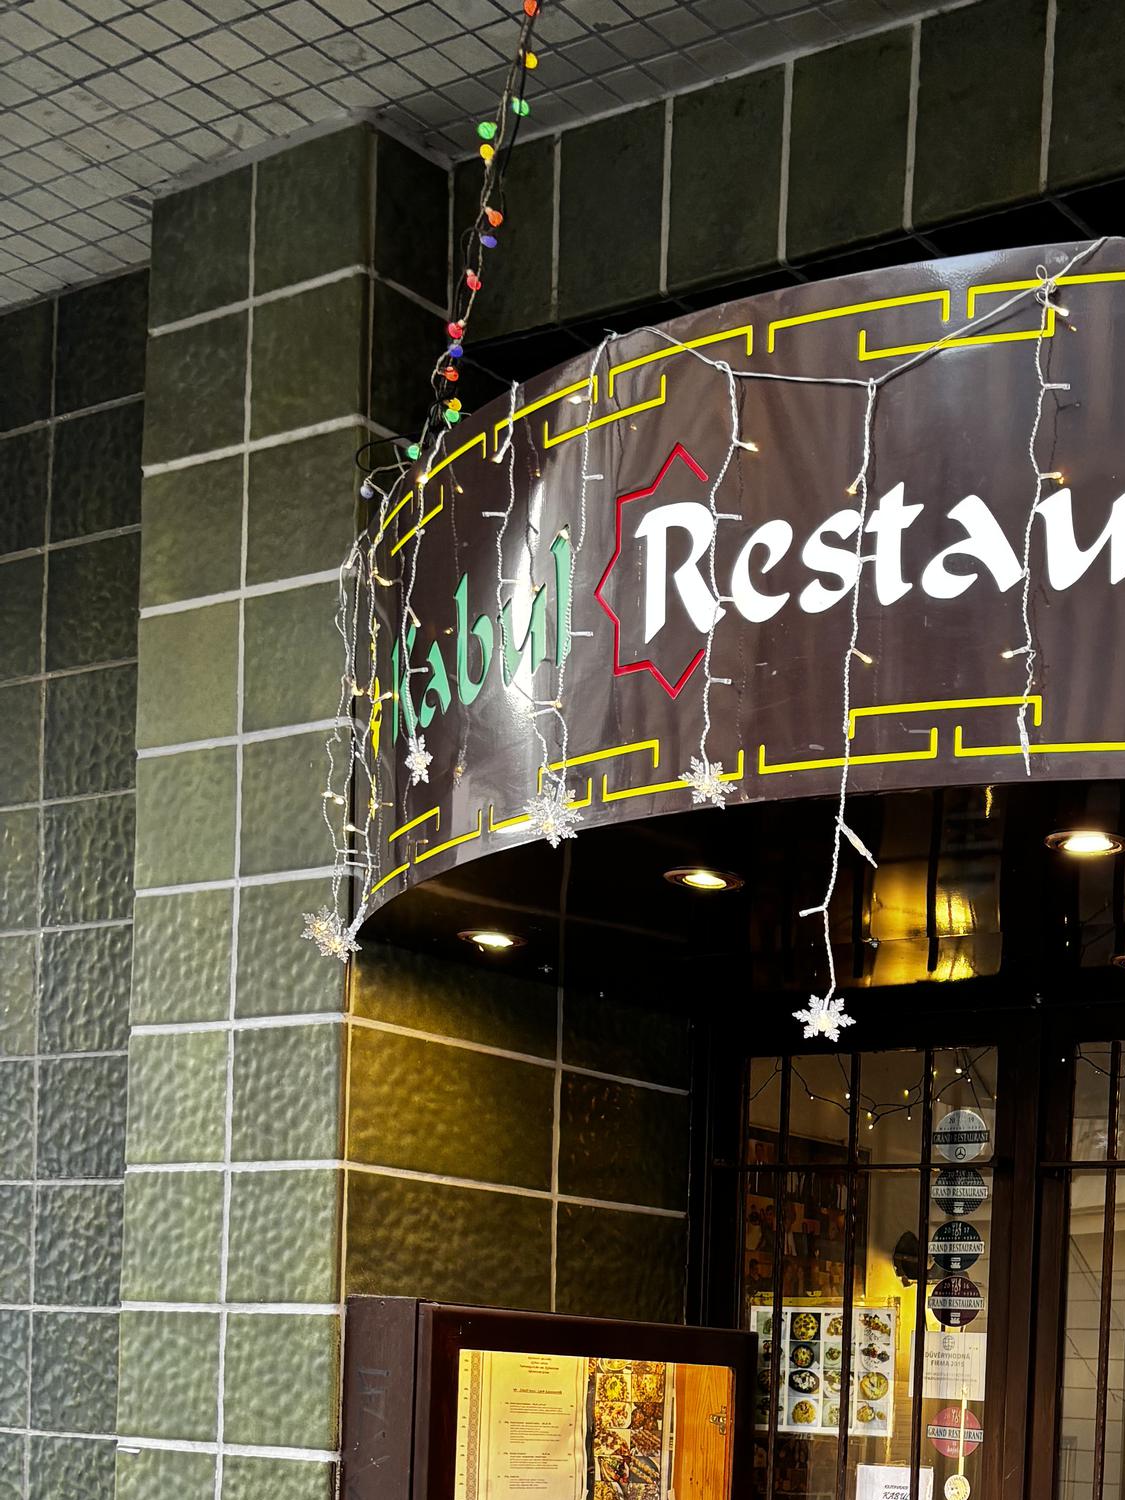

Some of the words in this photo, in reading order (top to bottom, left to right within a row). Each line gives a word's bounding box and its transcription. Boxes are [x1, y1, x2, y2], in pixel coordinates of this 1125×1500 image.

[392, 524, 572, 747] Kabul
[953, 1132, 989, 1142] RESTAURANT
[931, 1187, 951, 1197] GRAND
[951, 1187, 987, 1197] RESTAURANT
[929, 1243, 948, 1252] GRAND
[949, 1243, 984, 1252] RESTAURANT
[948, 1298, 984, 1308] RESTAURANT
[928, 1427, 948, 1438] GRAND
[948, 1429, 984, 1441] RESTURANT
